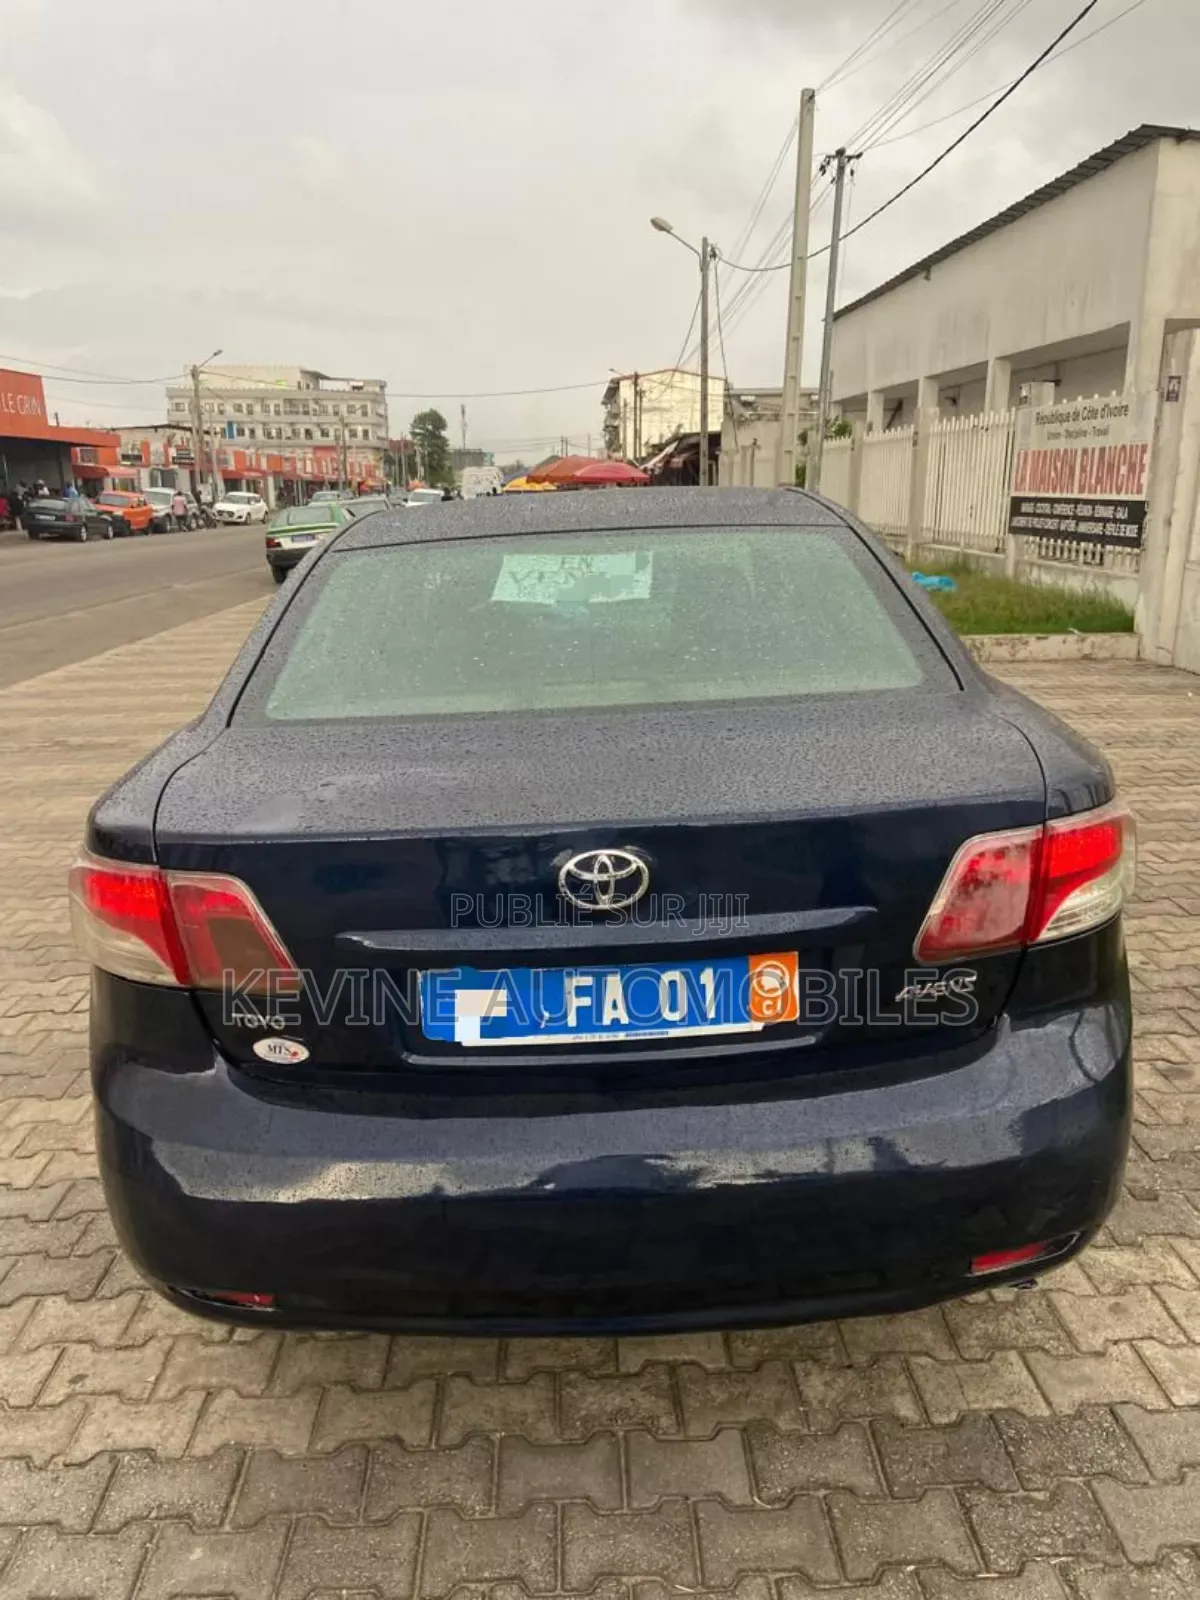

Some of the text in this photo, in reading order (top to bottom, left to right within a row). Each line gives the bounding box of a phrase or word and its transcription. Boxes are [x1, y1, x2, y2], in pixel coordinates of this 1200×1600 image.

[1036, 409, 1070, 427] République
[1072, 406, 1080, 422] de
[1014, 444, 1148, 495] LA MAISON BLANCHE
[566, 974, 629, 1027] FA
